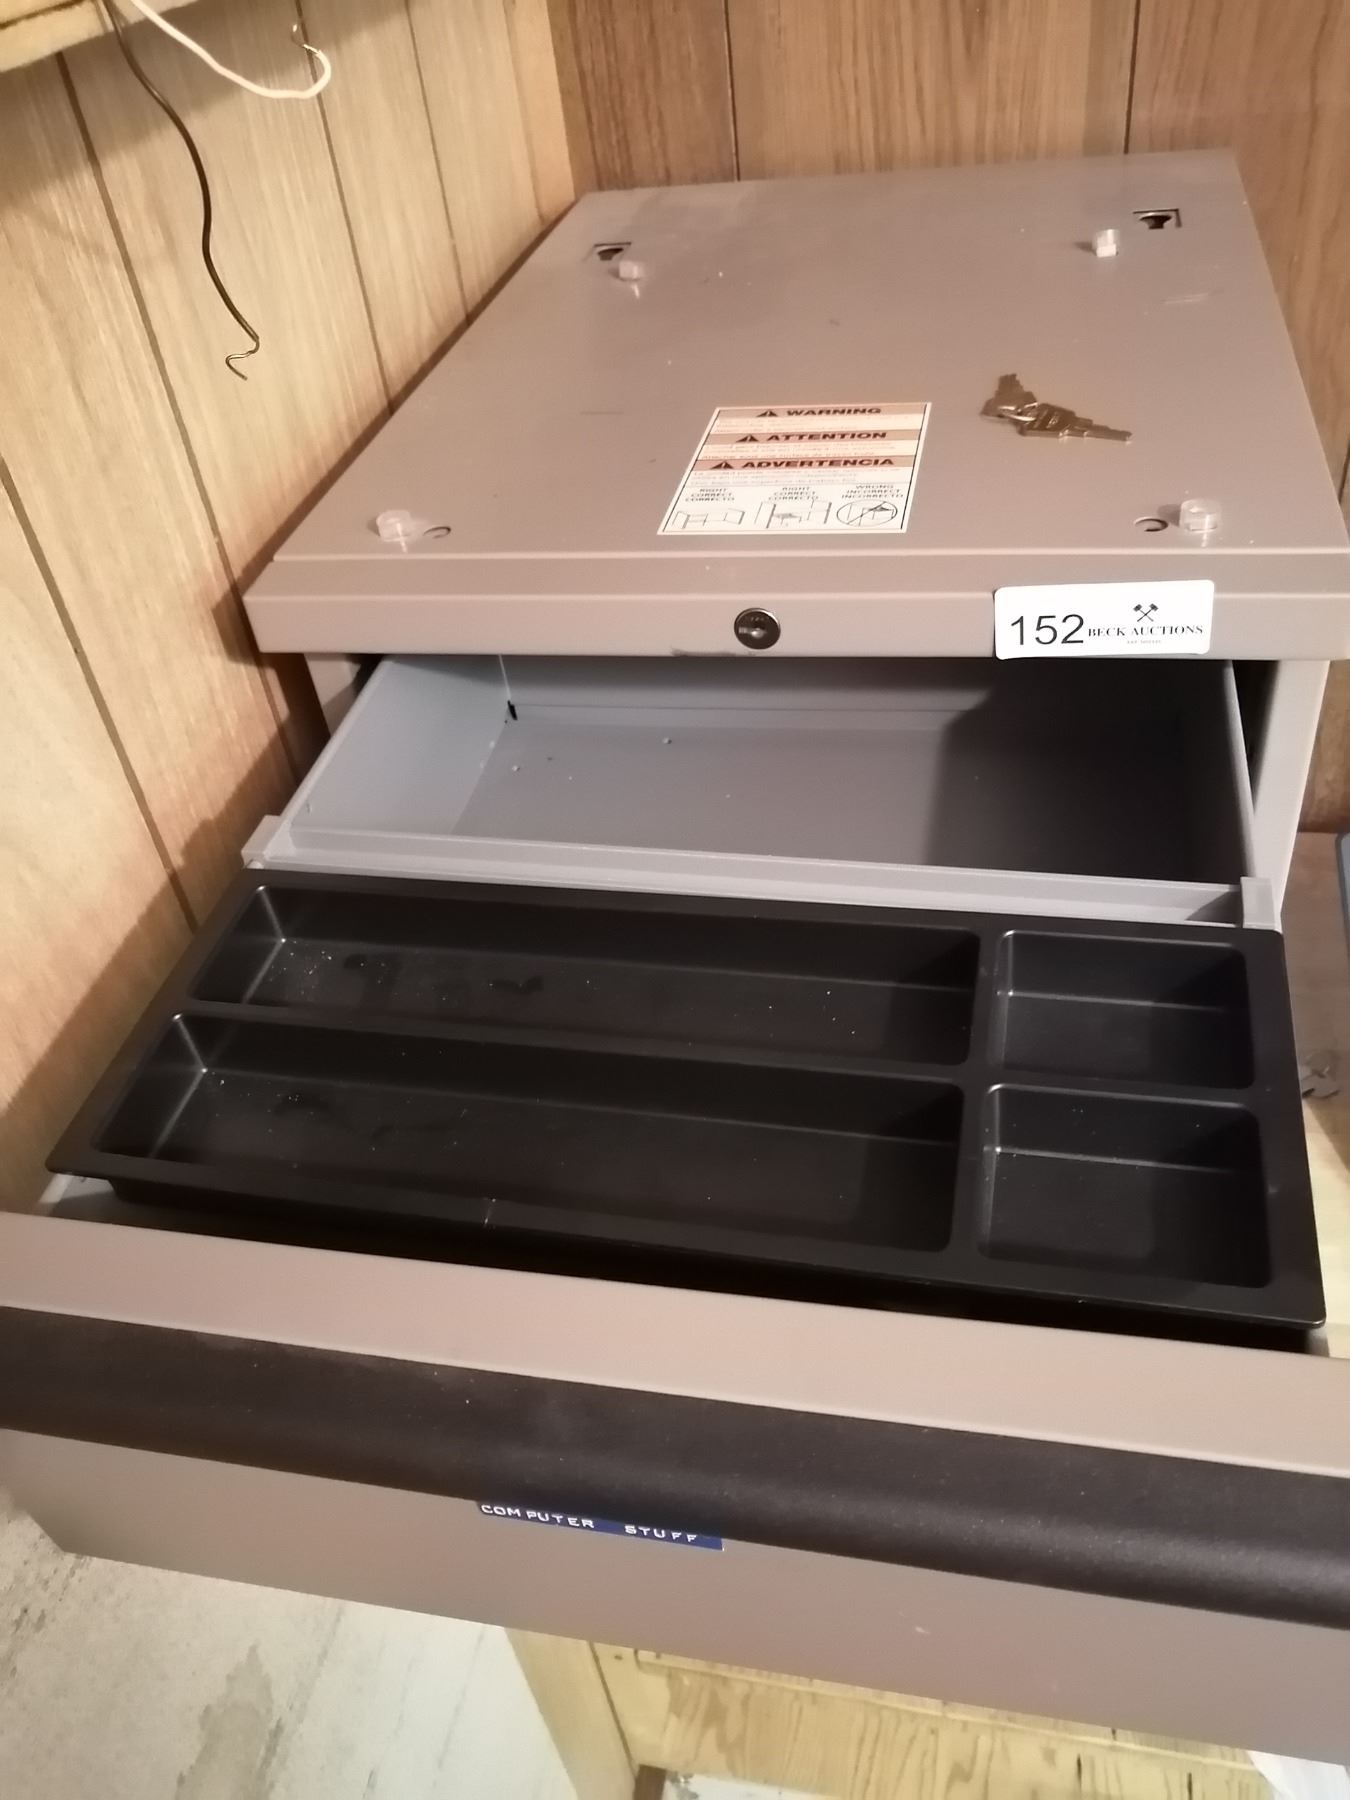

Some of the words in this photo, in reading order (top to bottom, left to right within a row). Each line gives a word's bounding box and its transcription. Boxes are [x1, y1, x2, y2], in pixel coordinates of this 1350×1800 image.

[786, 407, 882, 416] WARNING
[766, 432, 887, 443] ATTENTION
[741, 459, 895, 469] ADVERTENCIA
[1010, 613, 1085, 646] 152
[1088, 628, 1126, 637] BECK
[1132, 625, 1204, 636] AUCTIONS
[624, 1524, 697, 1543] STUFF
